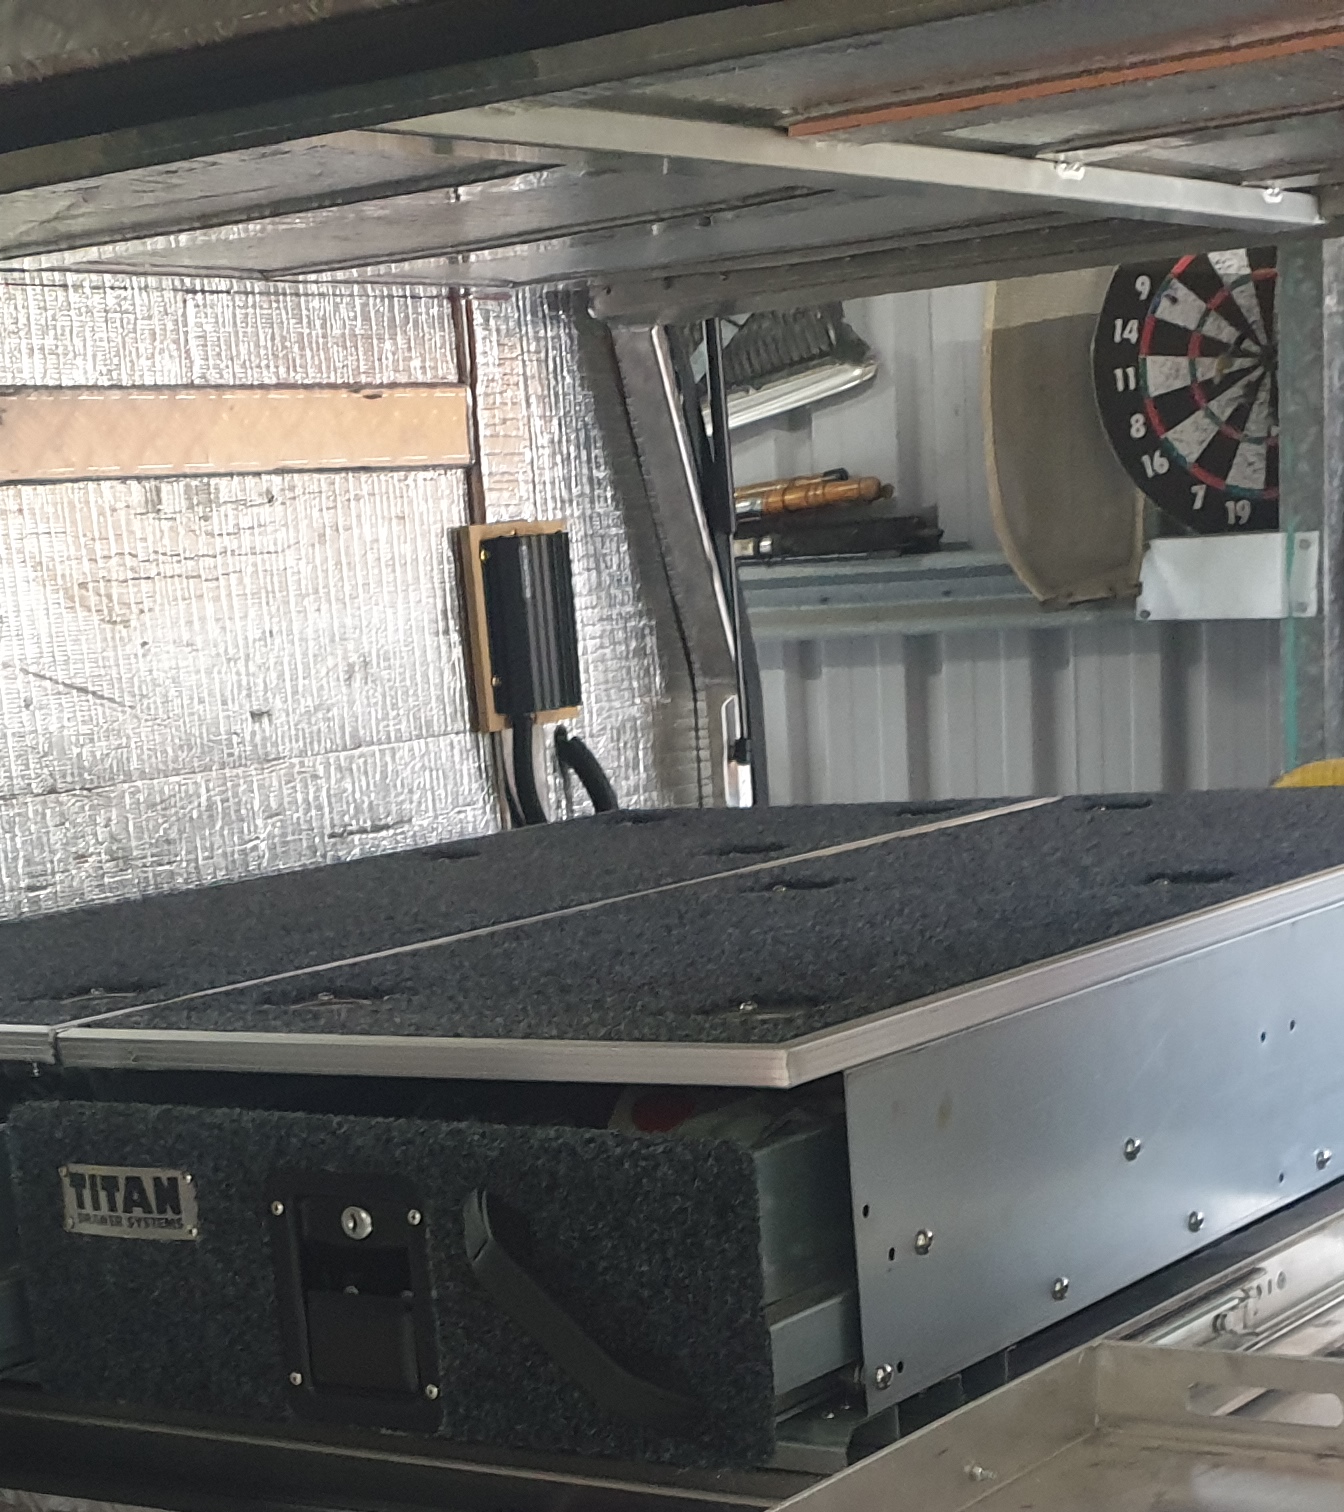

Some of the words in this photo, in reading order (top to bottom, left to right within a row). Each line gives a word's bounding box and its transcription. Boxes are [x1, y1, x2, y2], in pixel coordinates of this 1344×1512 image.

[1134, 275, 1152, 301] 9
[1113, 318, 1139, 344] 14
[1113, 366, 1137, 392] 11
[1129, 413, 1147, 439] 8
[1141, 450, 1170, 478] 16
[1191, 485, 1207, 510] 7
[1225, 500, 1251, 525] 19
[69, 1172, 182, 1215] TITAN
